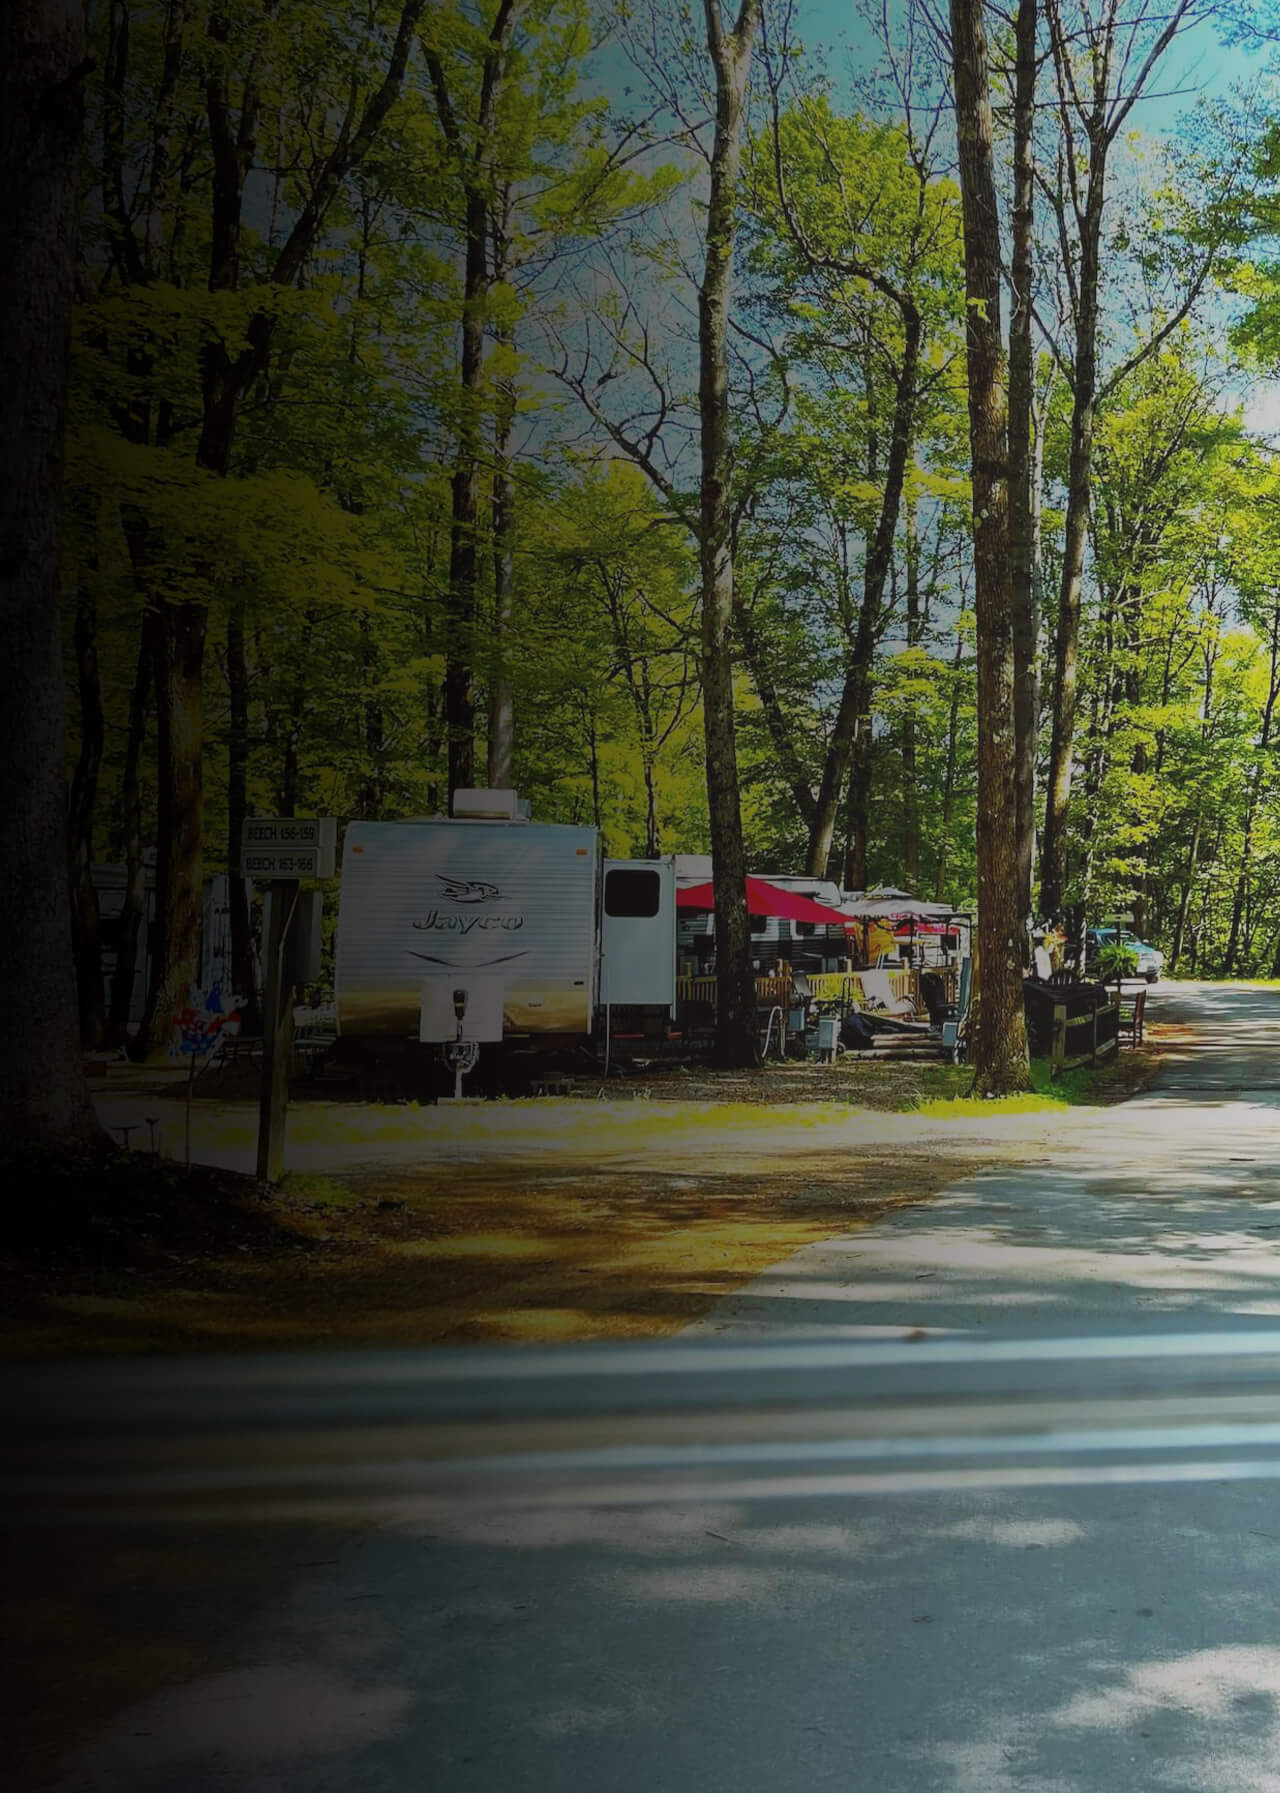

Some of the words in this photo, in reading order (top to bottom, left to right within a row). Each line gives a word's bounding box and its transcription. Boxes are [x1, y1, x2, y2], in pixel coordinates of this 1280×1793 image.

[248, 826, 276, 840] BEECH
[247, 856, 275, 870] BEECH
[411, 911, 527, 934] Jayco
